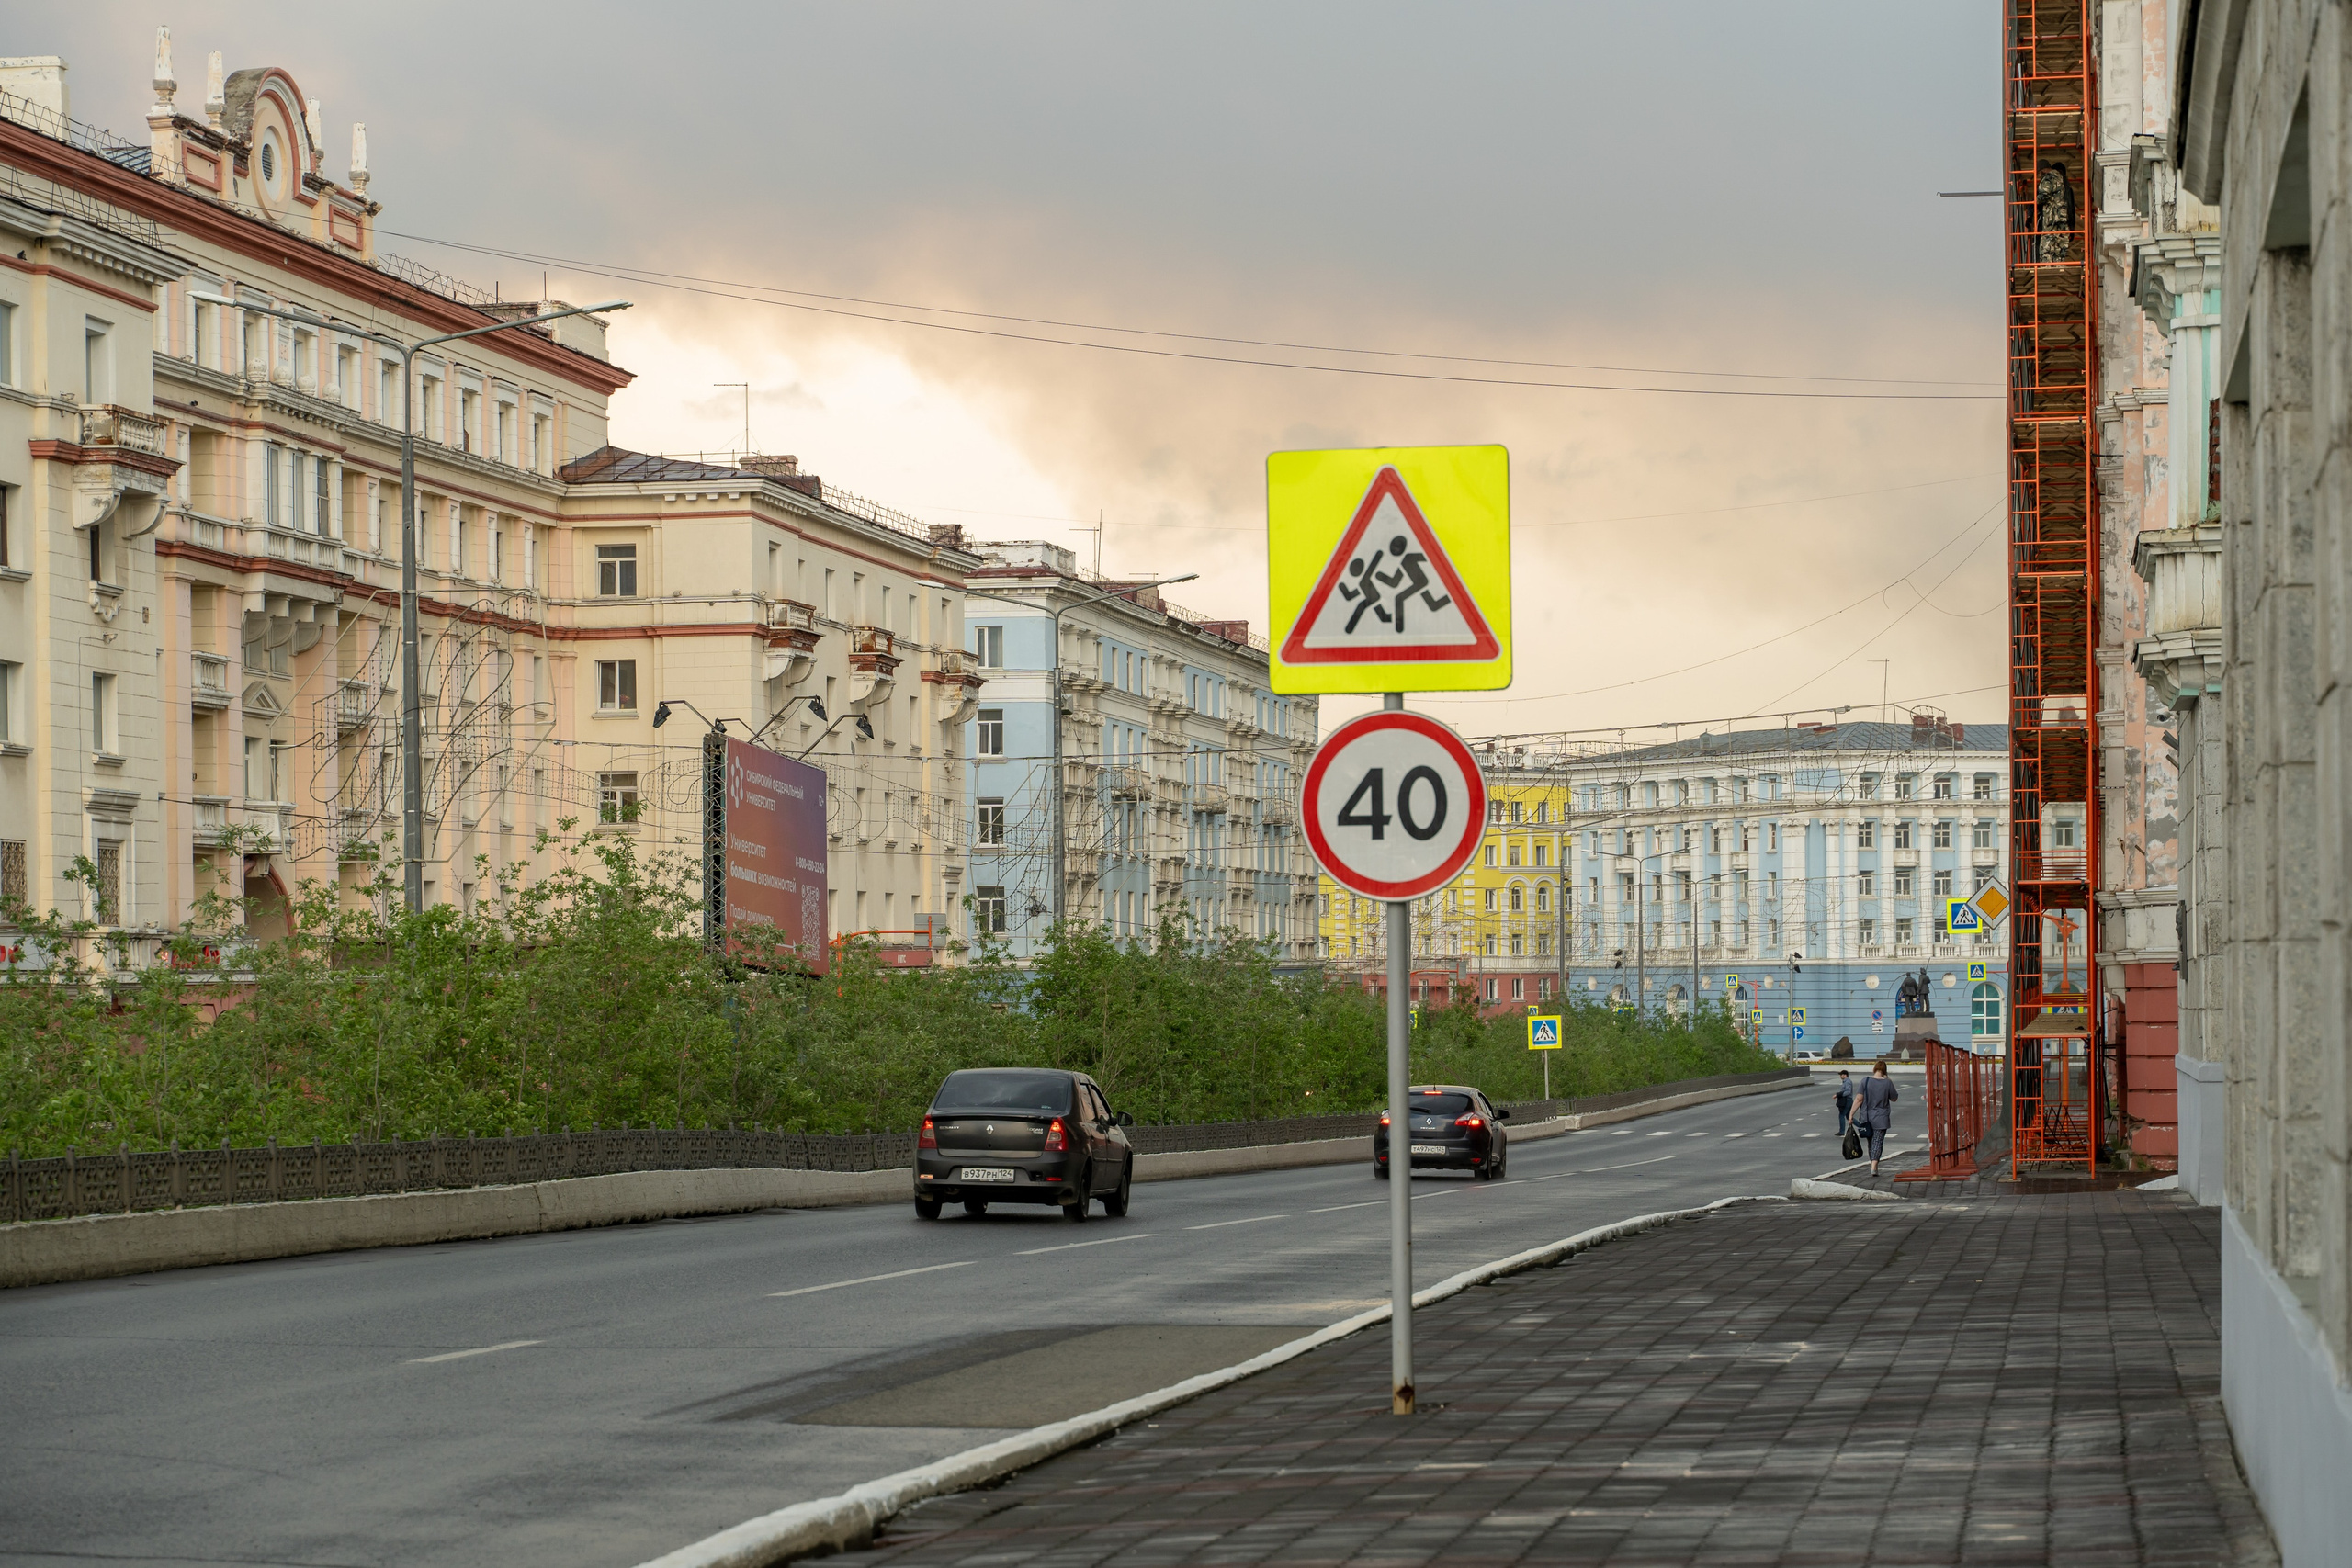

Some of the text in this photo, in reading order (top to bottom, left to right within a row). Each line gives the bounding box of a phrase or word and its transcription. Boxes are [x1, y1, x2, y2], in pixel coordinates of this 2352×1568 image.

[746, 770, 804, 800] СИБИРСКИЙ ФЕДЕРАЛЬНЫЙ
[746, 790, 776, 811] УНИВЕРСИТЕТ
[1337, 764, 1448, 841] 40
[730, 833, 766, 858] Университет
[730, 860, 797, 893] больших возможностей
[730, 903, 746, 920] Подай
[964, 1168, 1012, 1179] В937РН 124
